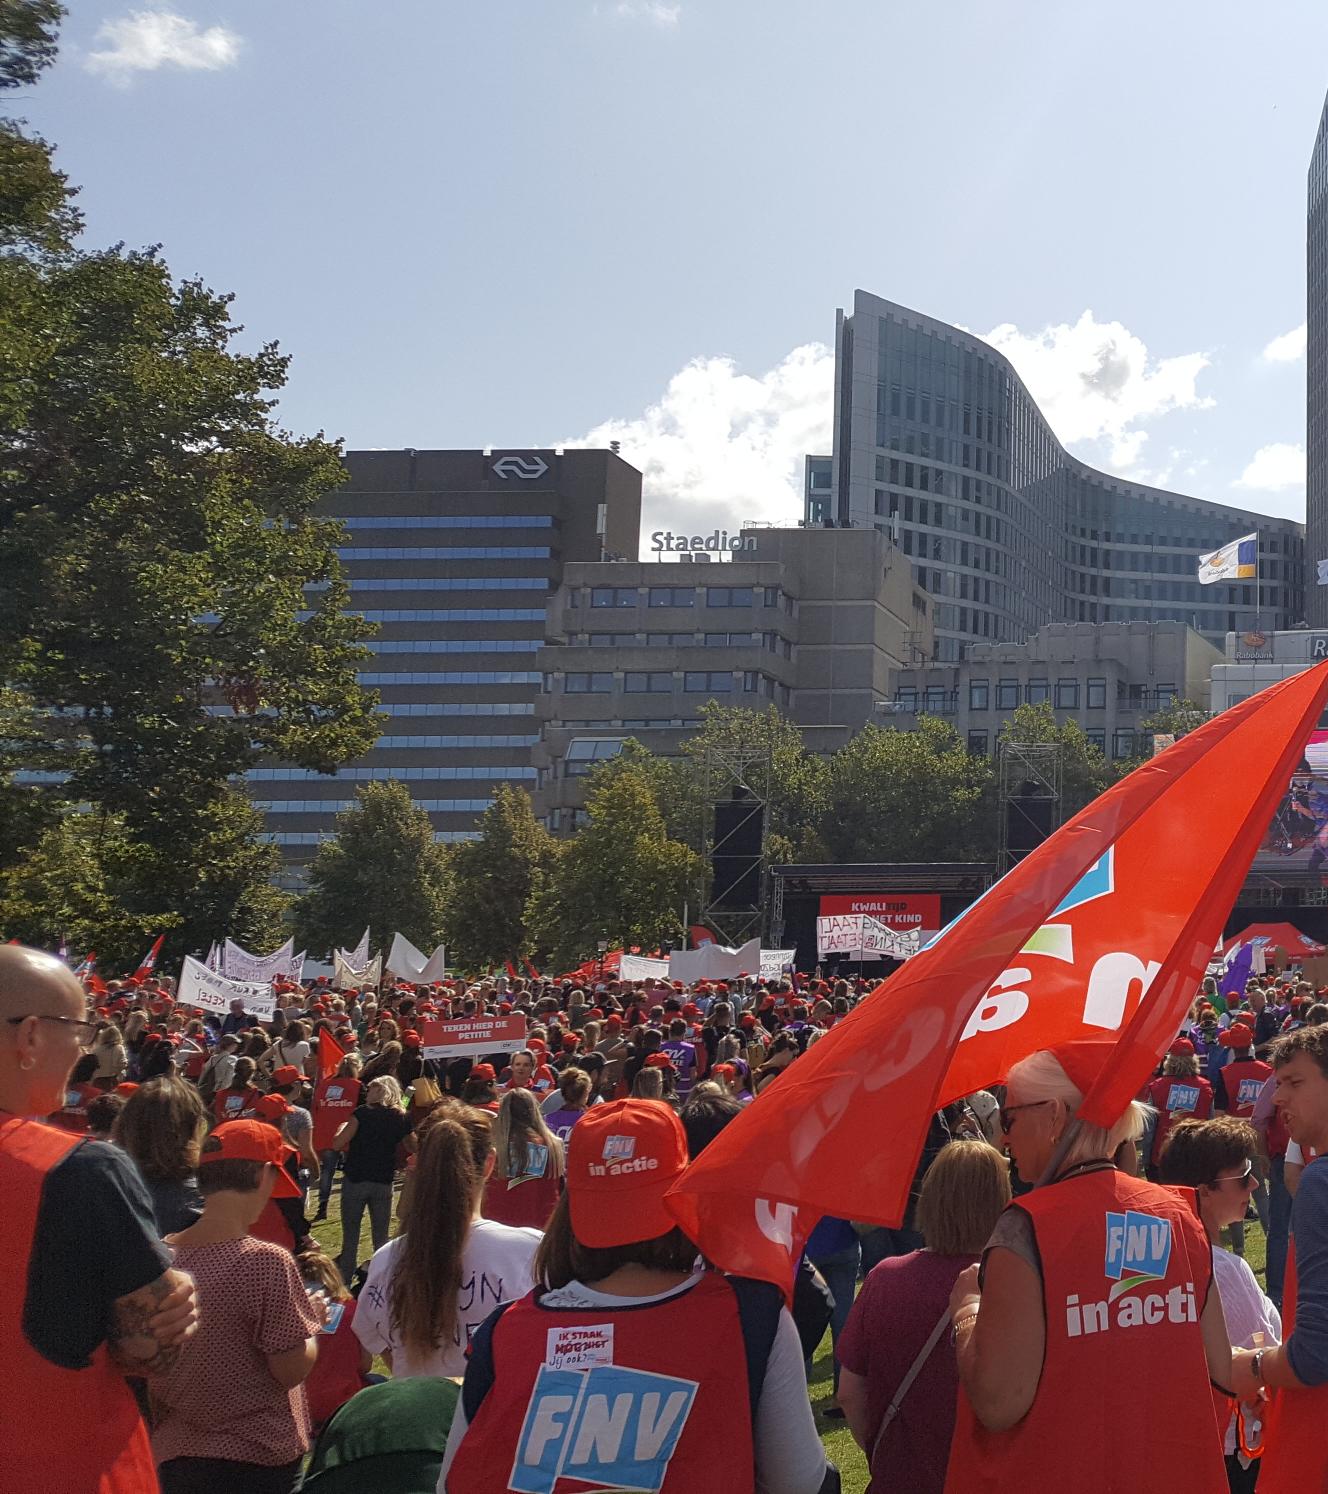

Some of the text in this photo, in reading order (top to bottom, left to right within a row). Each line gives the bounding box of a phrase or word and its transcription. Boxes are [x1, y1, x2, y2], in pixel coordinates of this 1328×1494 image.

[651, 530, 758, 551] Staedion
[1236, 651, 1273, 659] Rabobank
[894, 914, 922, 923] KIND
[442, 1020, 509, 1033] TEKEN HIER DE
[458, 1030, 492, 1040] PETITIE
[1167, 1088, 1198, 1107] FNV
[607, 1138, 635, 1155] FNV
[589, 1157, 659, 1177] in actie
[1107, 1223, 1169, 1264] FNV
[1066, 1282, 1198, 1338] in acti
[559, 1330, 604, 1341] IK STAAK
[524, 1391, 689, 1466] FNV
